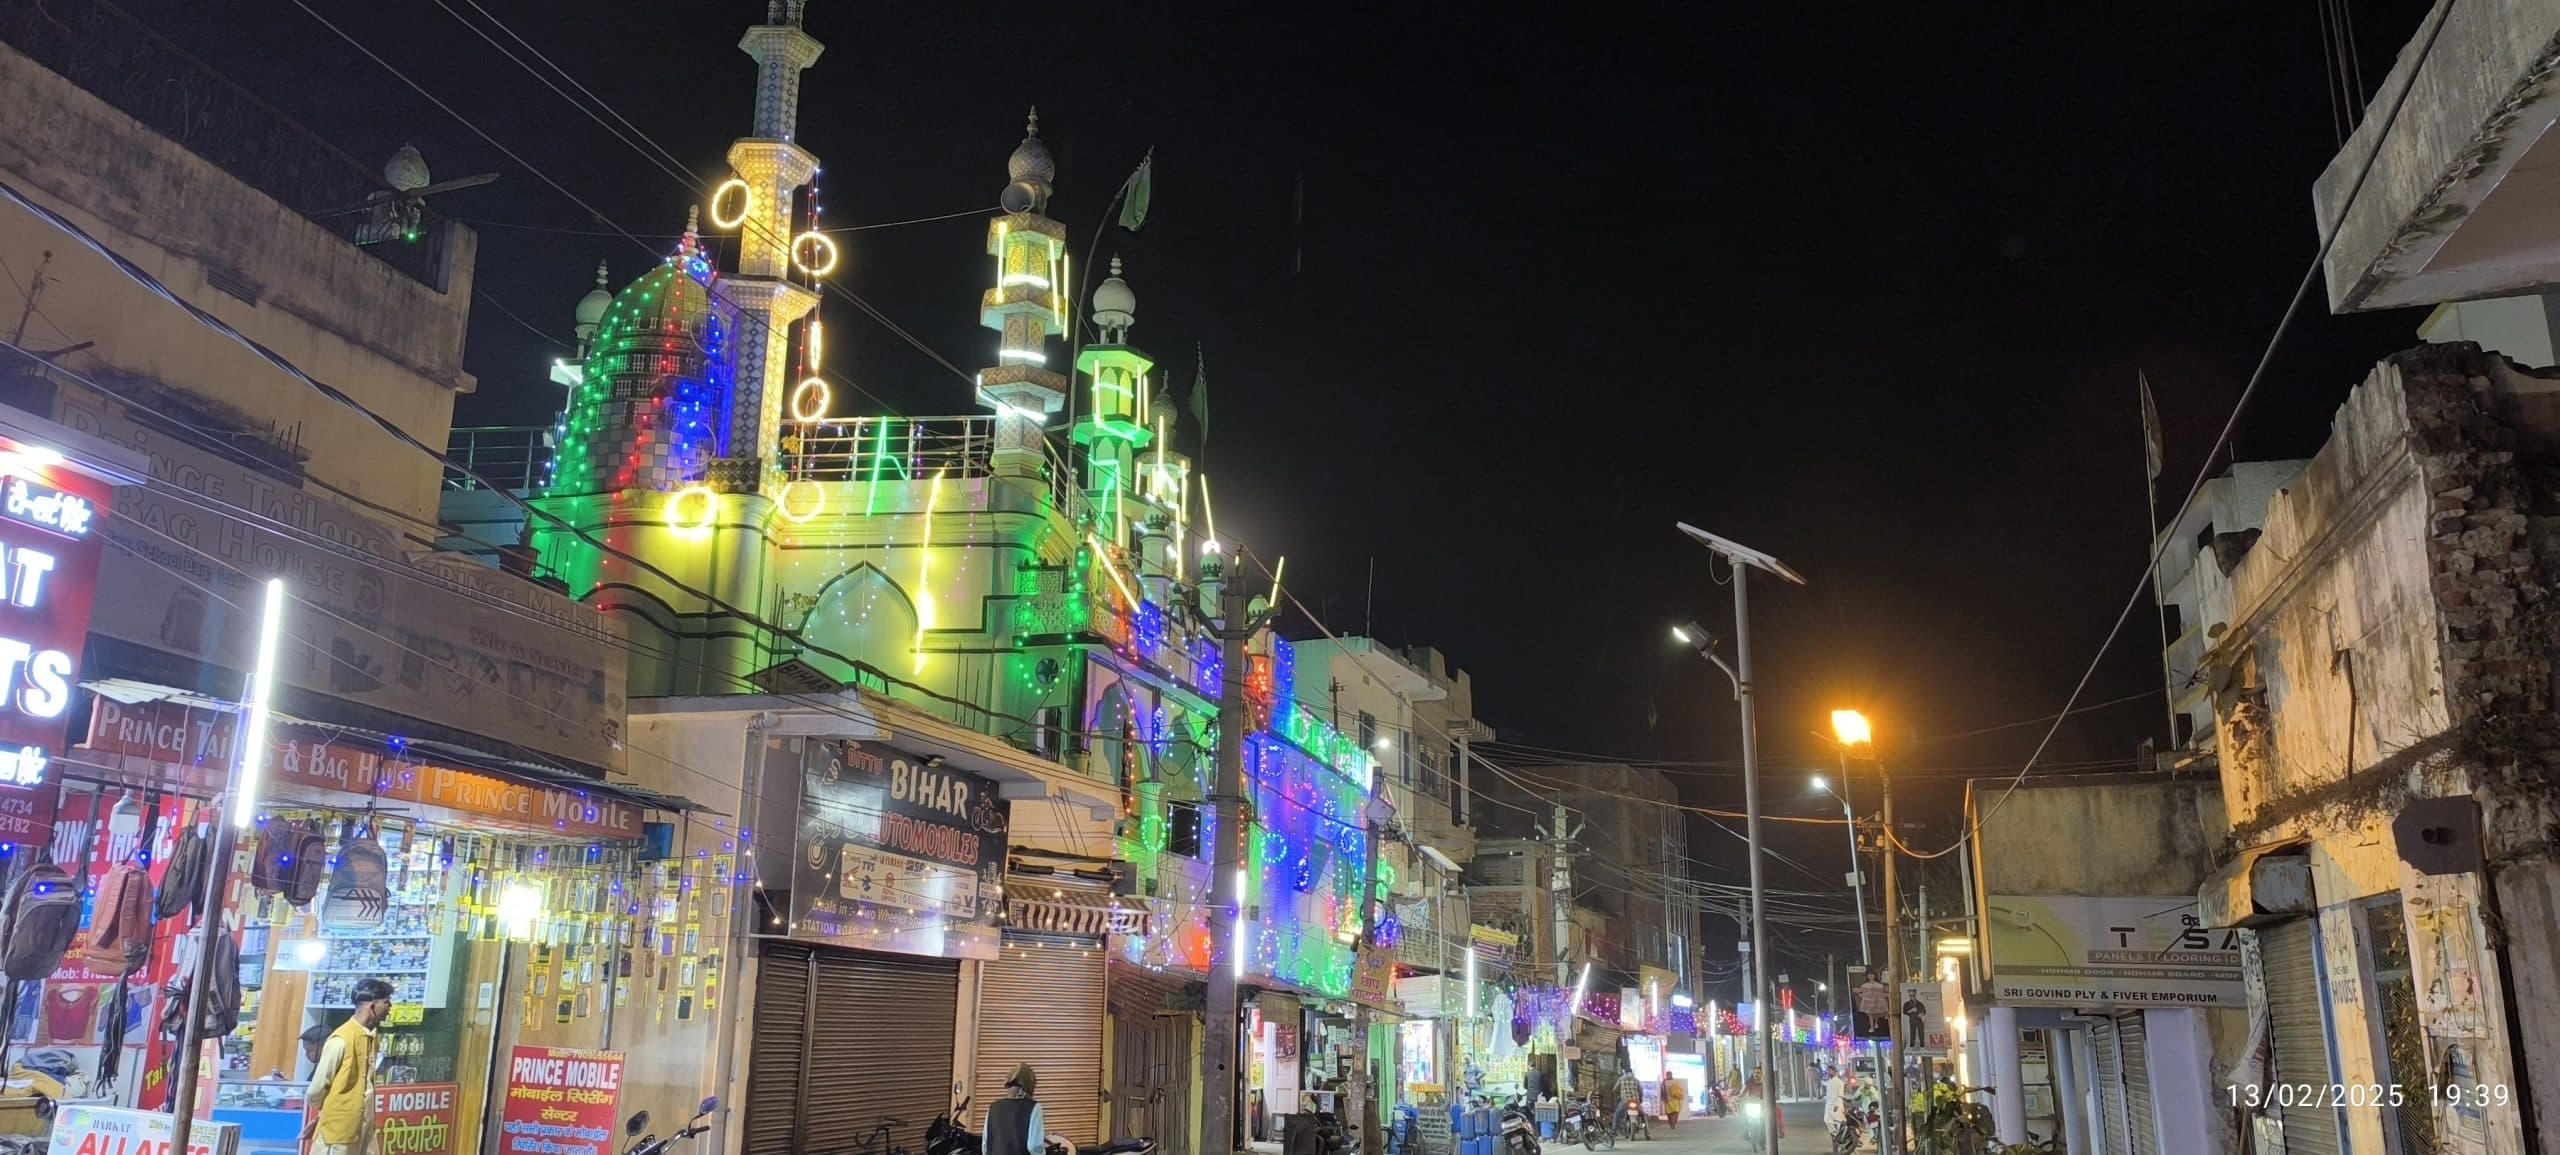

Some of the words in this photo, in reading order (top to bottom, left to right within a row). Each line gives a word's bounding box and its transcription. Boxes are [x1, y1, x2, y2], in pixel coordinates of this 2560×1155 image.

[309, 744, 348, 788] BAG
[890, 759, 969, 821] BIHAR
[802, 918, 834, 934] STATION
[2095, 952, 2144, 962] PANELS
[2004, 987, 2023, 998] SRI
[2026, 988, 2071, 999] GOVIND
[2075, 989, 2096, 1000] PLY
[2101, 990, 2109, 1000] &
[2113, 990, 2148, 1001] FIVER
[2152, 992, 2218, 1003] EMPORIUM
[512, 1057, 565, 1086] PRINCE
[565, 1060, 620, 1090] MOBILE
[389, 1090, 450, 1111] MOBILE
